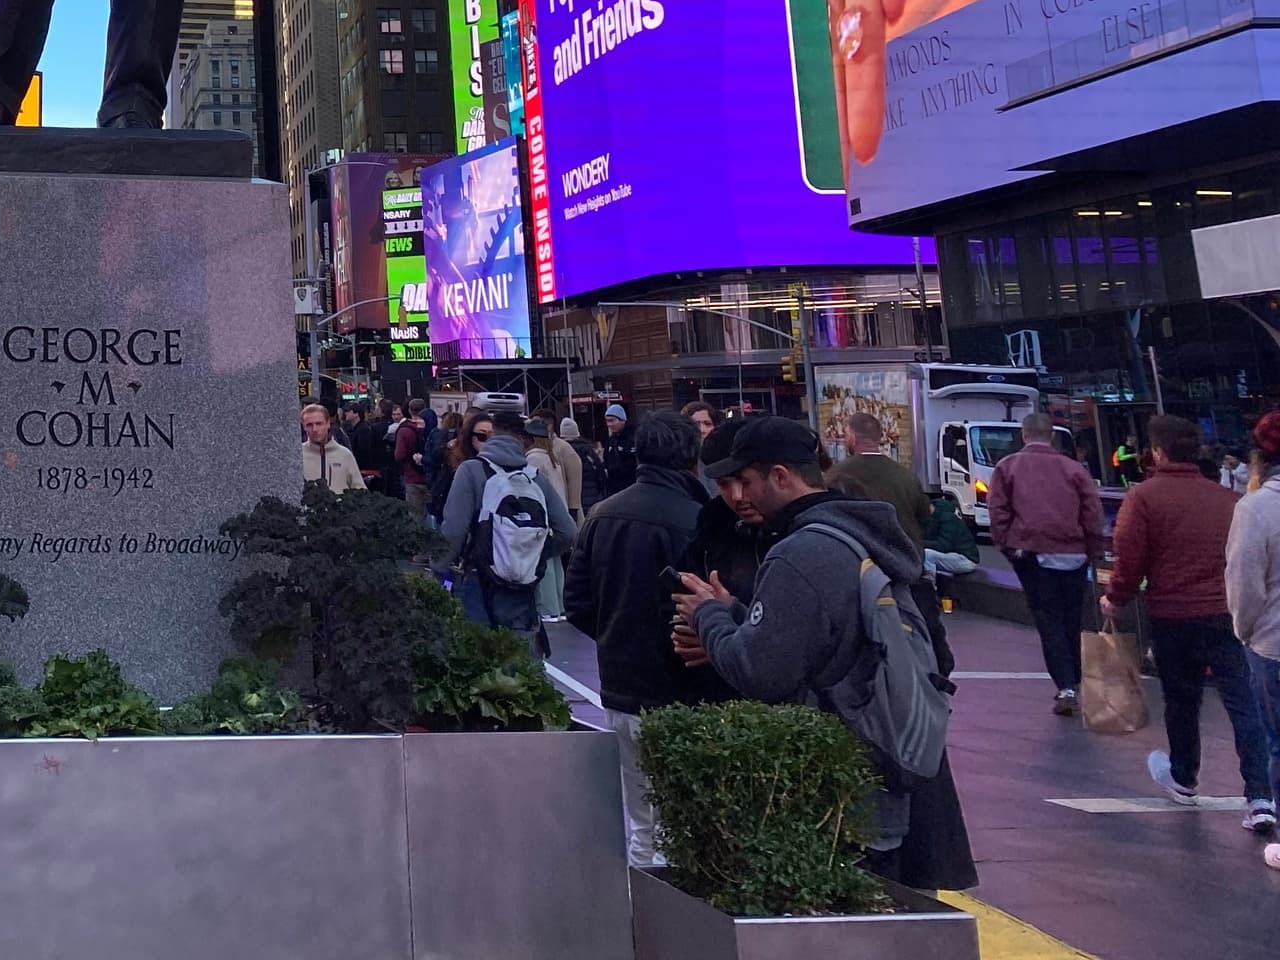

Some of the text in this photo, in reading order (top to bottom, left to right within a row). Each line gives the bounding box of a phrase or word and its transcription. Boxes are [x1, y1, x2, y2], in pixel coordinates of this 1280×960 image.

[553, 16, 583, 86] and
[921, 62, 999, 121] ANYTHING
[529, 114, 548, 202] COME
[562, 152, 610, 198] WONDERY
[403, 283, 429, 312] DA
[2, 326, 183, 366] GEORGE
[76, 371, 118, 407] M
[15, 410, 176, 450] COHAN
[36, 467, 154, 497] 1878-1942
[29, 532, 112, 563] Regards
[119, 532, 138, 554] to
[143, 532, 244, 562] Broadway
